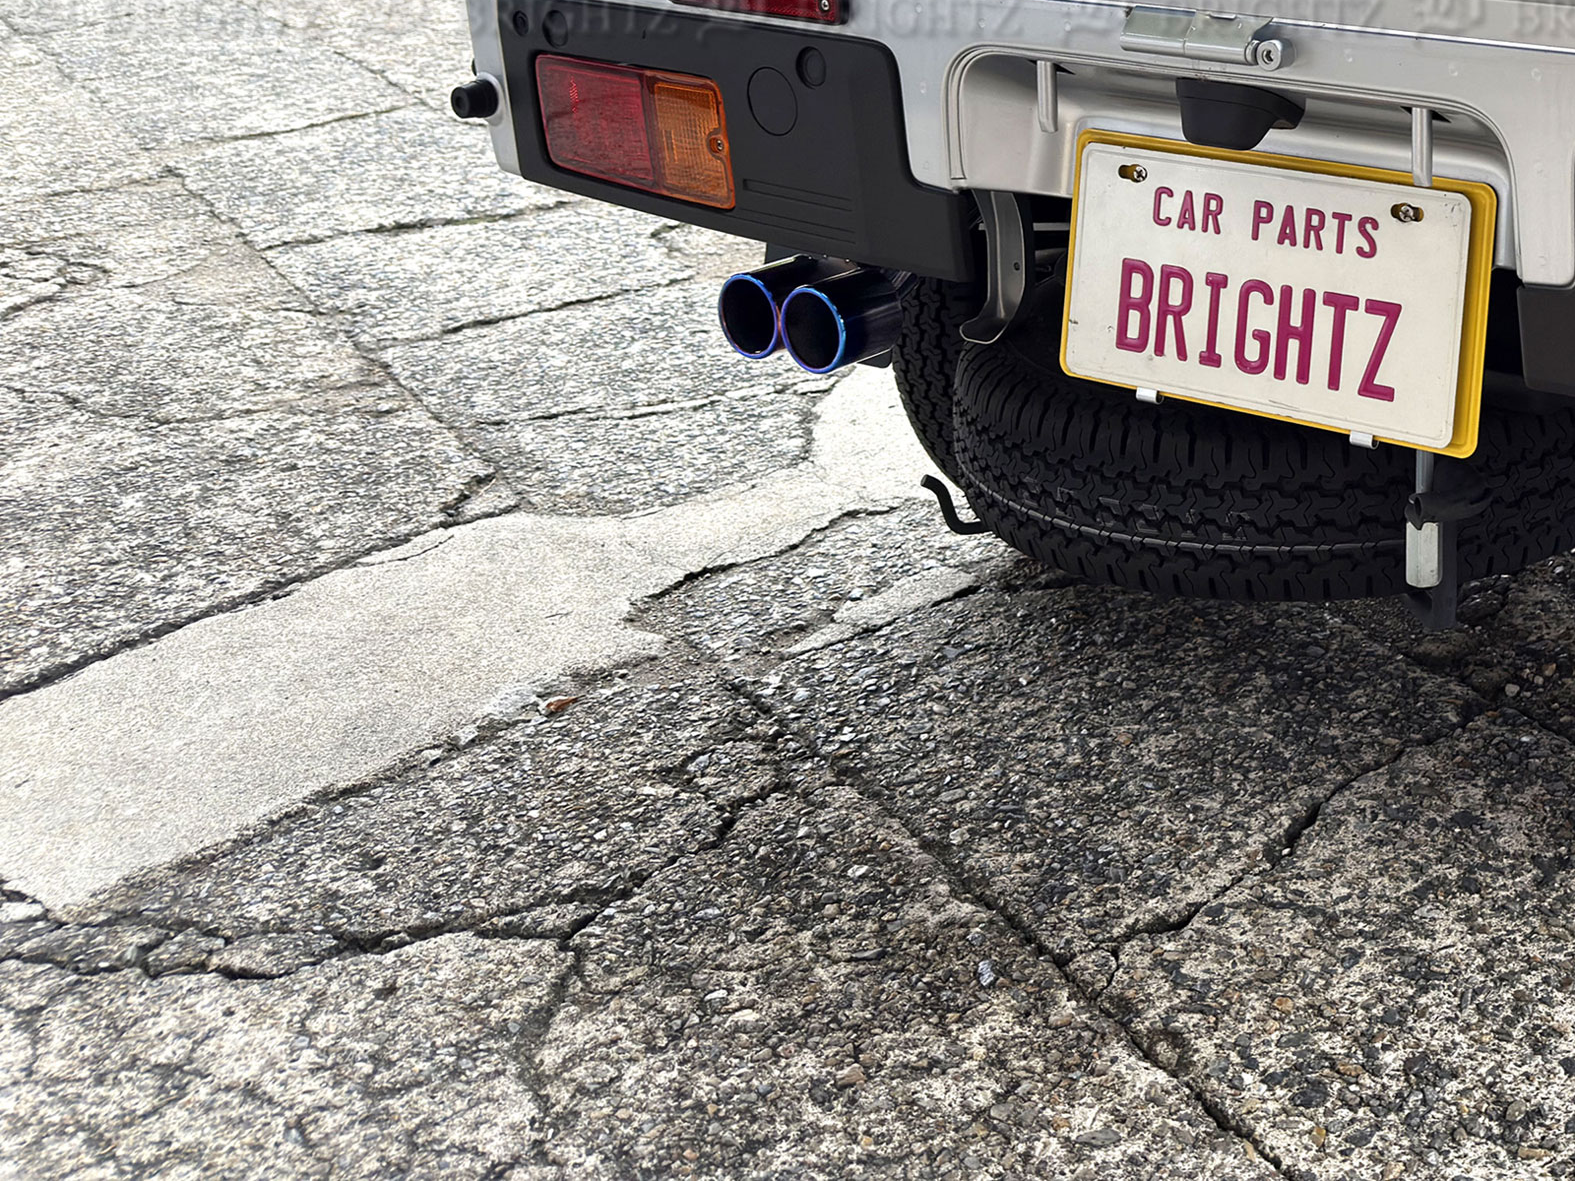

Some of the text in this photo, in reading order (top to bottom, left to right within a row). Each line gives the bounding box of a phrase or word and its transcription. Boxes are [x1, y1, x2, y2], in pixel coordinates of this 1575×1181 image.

[1152, 186, 1380, 259] CAR PARTS
[1115, 257, 1403, 402] BRIGHTZ
